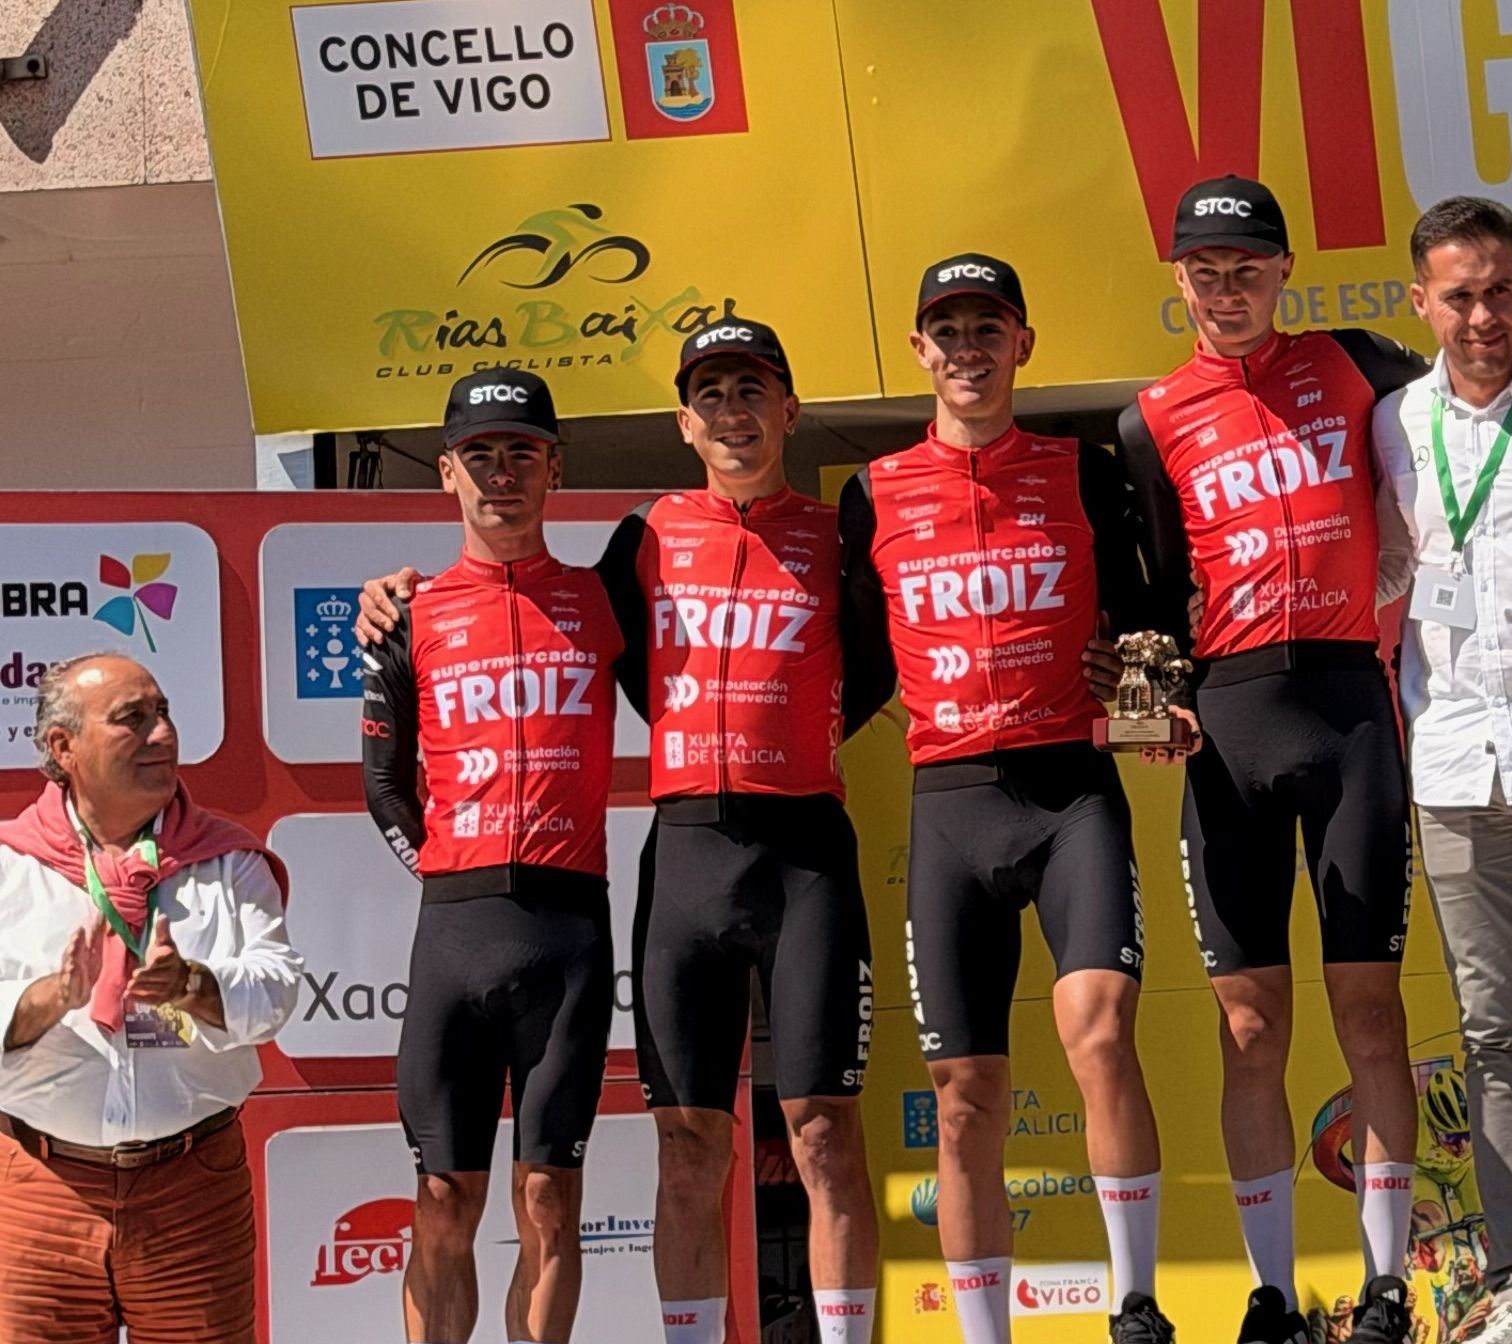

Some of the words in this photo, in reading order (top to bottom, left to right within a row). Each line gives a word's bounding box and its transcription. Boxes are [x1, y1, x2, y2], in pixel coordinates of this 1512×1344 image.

[319, 22, 574, 73] CONCELLO
[356, 81, 420, 120] DE
[434, 74, 551, 116] VIGO
[376, 362, 453, 378] CLUB
[473, 354, 612, 371] CICLISTA
[1191, 431, 1352, 521] FROIZ
[900, 561, 1067, 624] FROIZ
[654, 599, 817, 653] FROIZ
[433, 667, 596, 730] FROIZ
[1006, 1175, 1095, 1197] cobeo
[1040, 1286, 1101, 1305] VIGO
